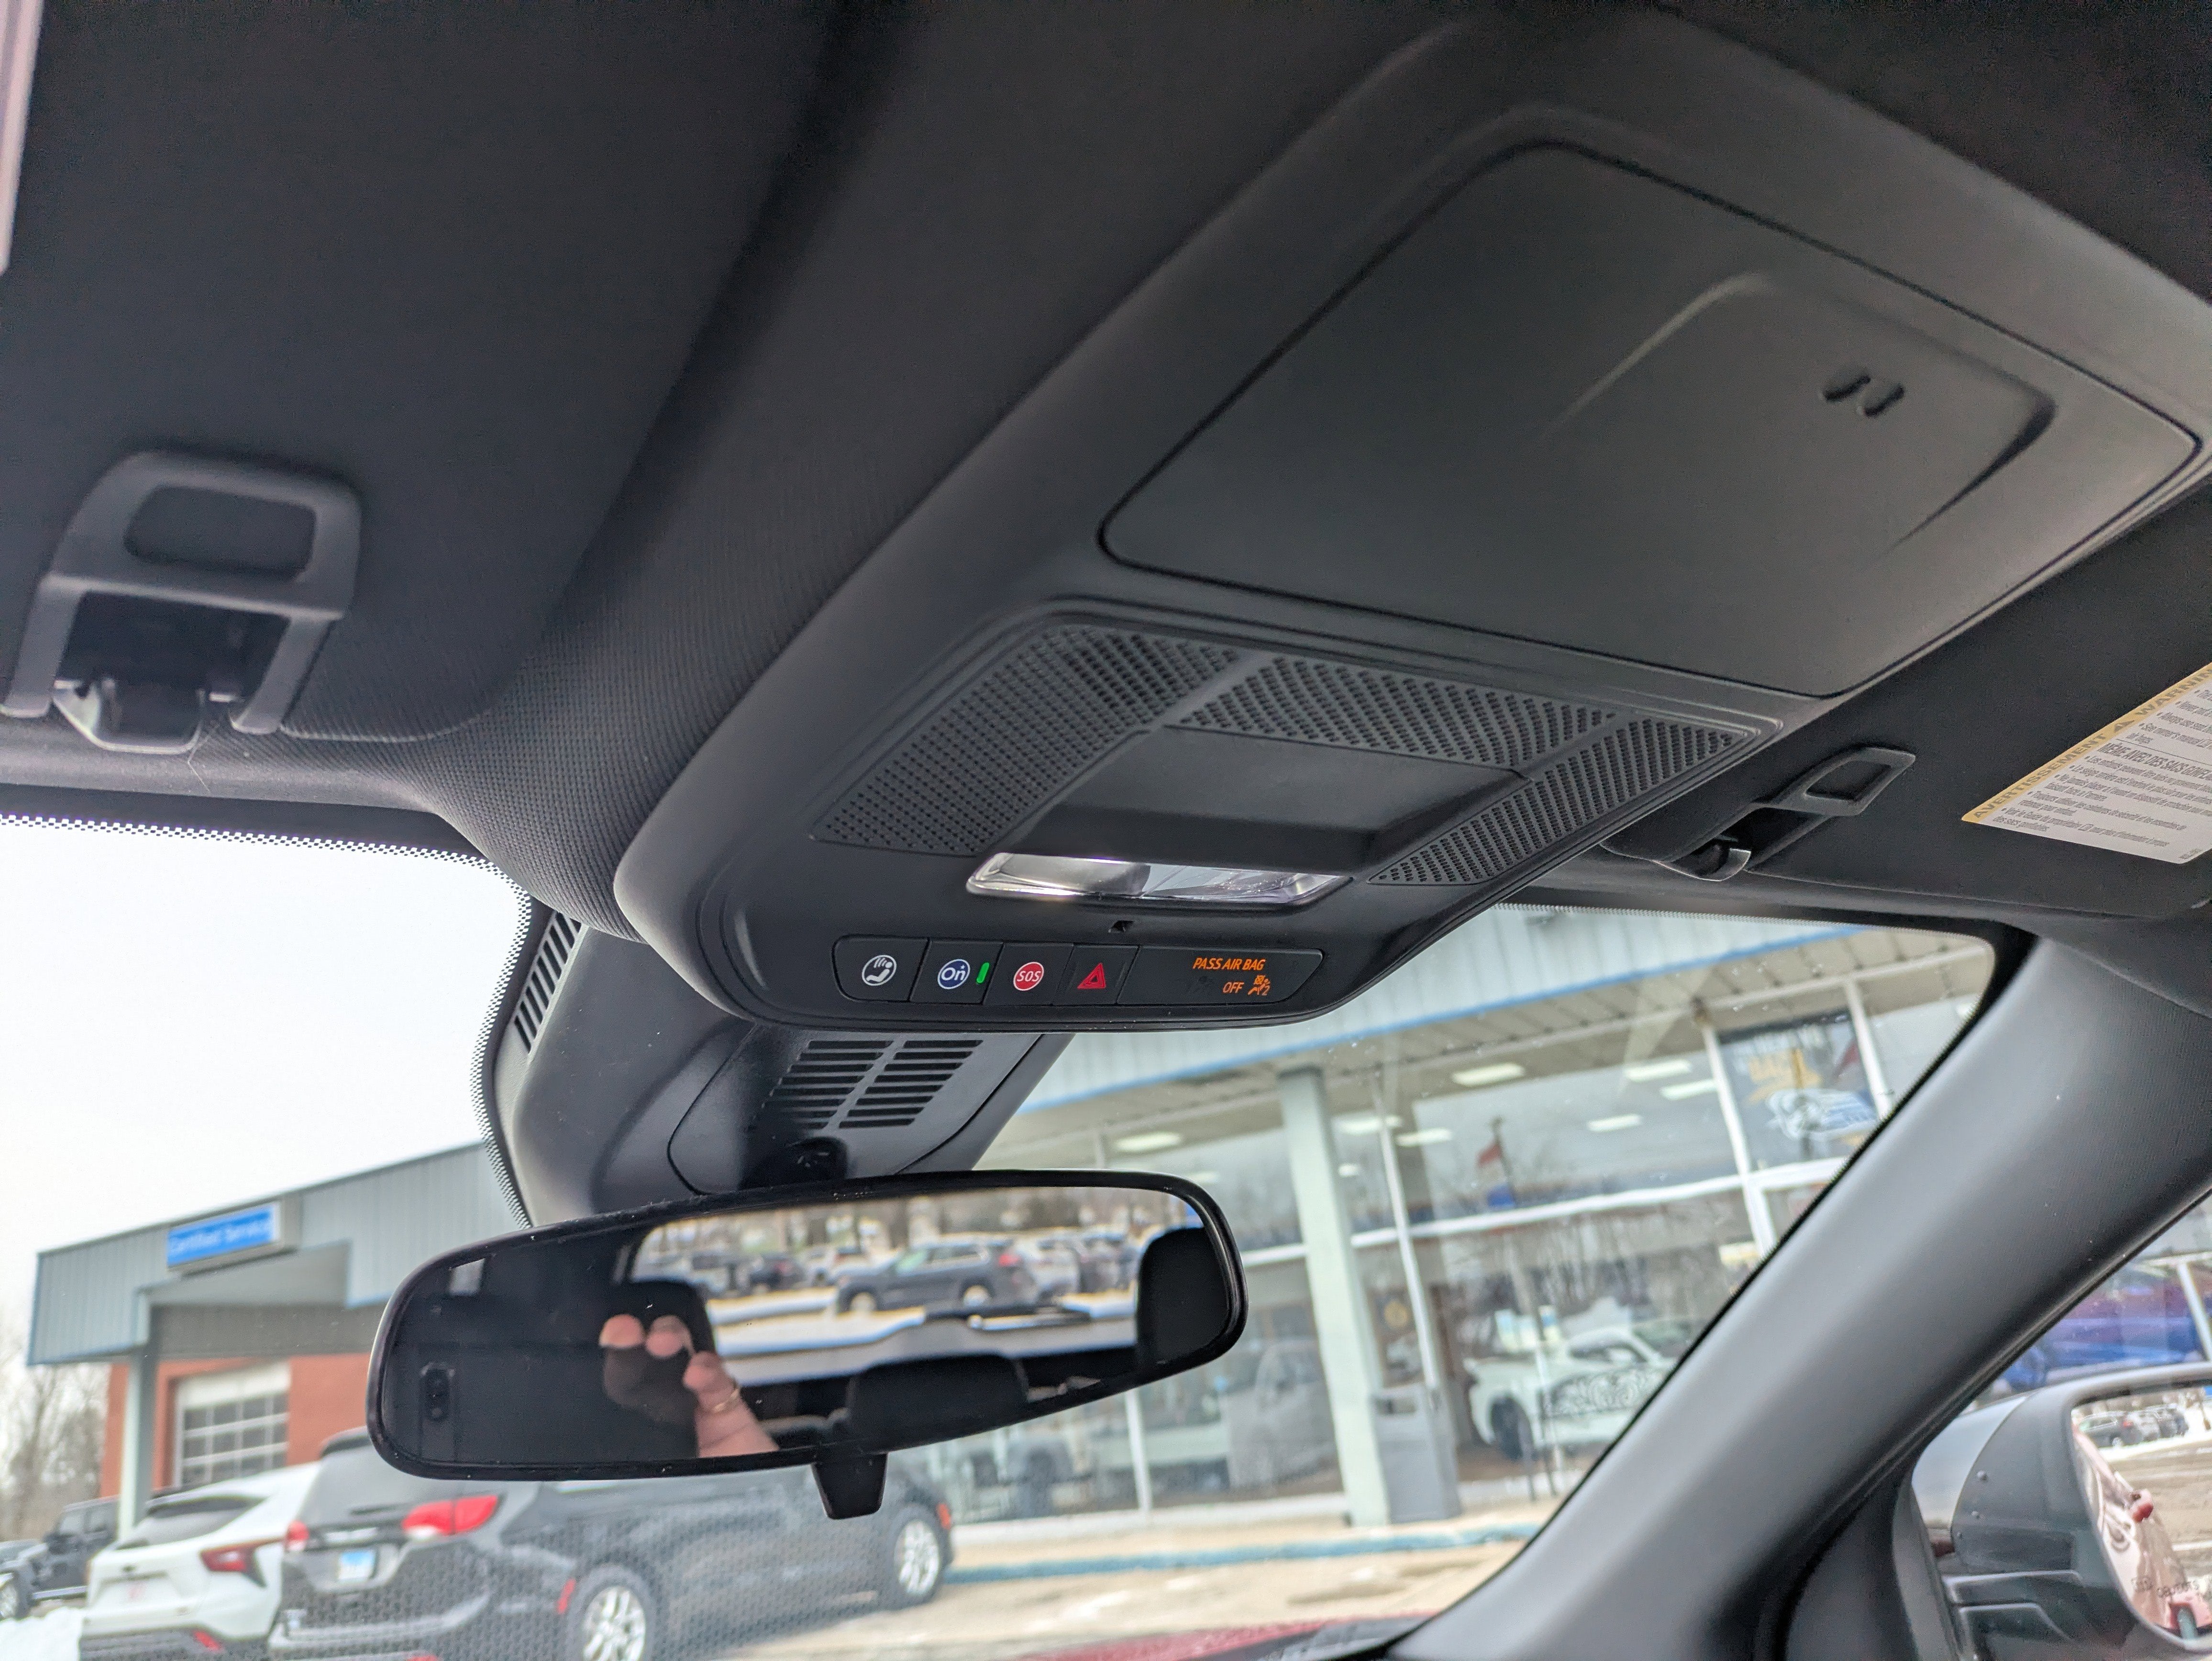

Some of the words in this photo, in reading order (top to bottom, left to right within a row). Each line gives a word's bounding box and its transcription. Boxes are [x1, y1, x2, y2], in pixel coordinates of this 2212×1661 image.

[1974, 733, 2105, 818] AVERTISSEMENT
[2135, 669, 2212, 715] WARNIN
[2097, 743, 2131, 757] MÊME
[2122, 750, 2152, 763] AVEC
[2143, 756, 2168, 767] DES
[2160, 761, 2189, 773] SACS
[1193, 957, 1223, 969] PASS
[1221, 958, 1242, 970] AIR
[1242, 959, 1266, 970] BAG
[941, 966, 966, 981] On
[1017, 970, 1041, 982] SOS
[1222, 982, 1245, 994] OFF
